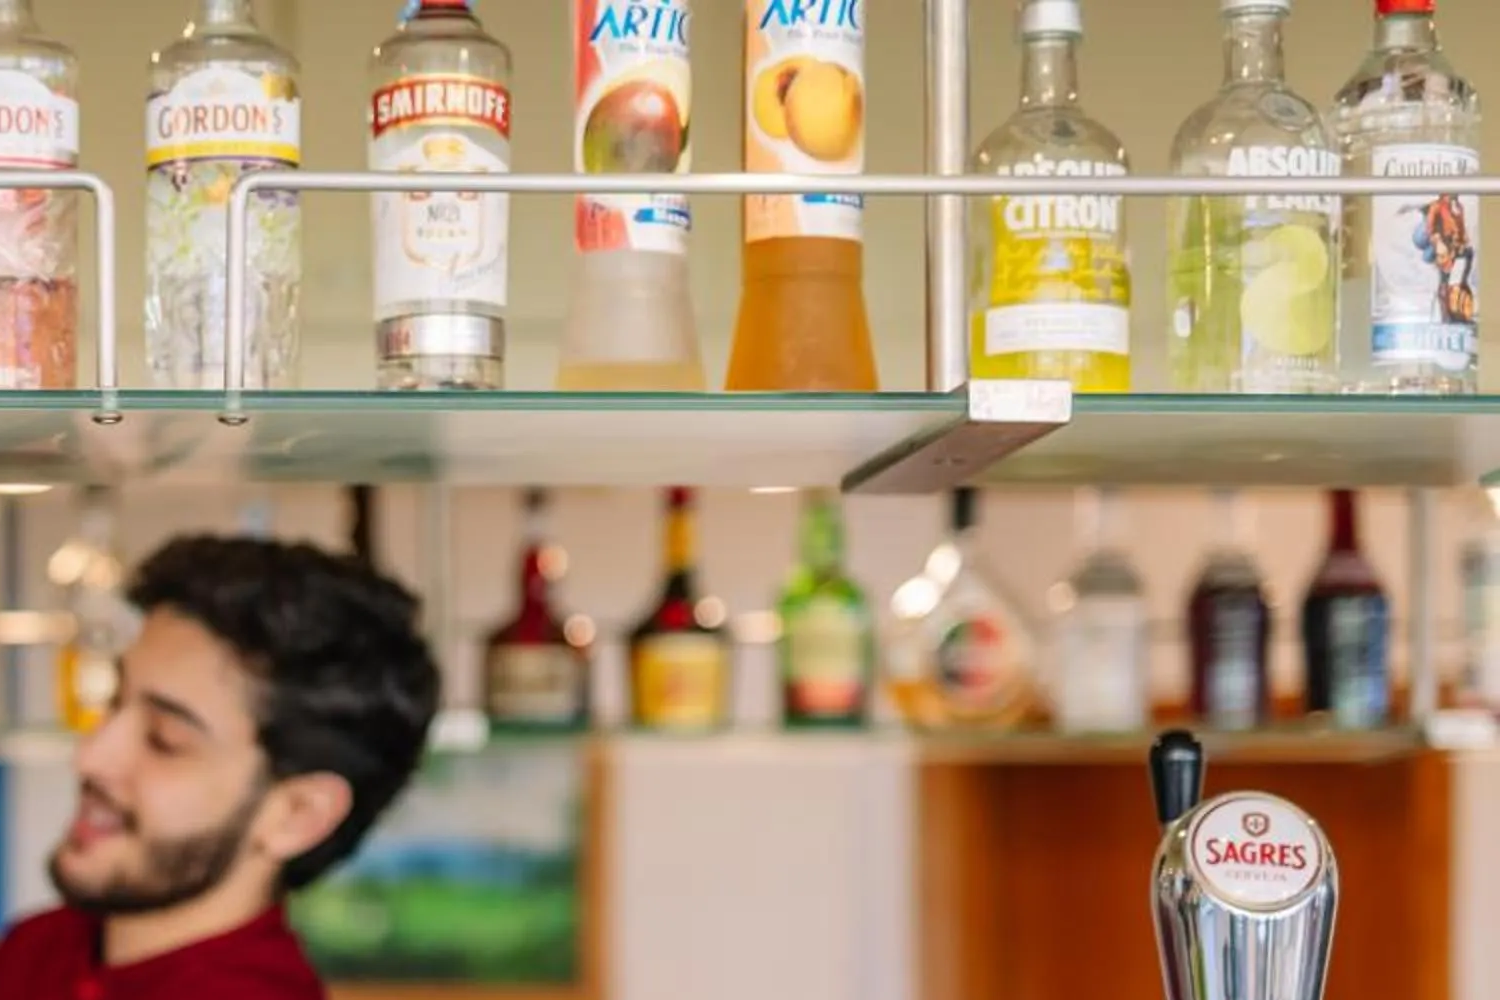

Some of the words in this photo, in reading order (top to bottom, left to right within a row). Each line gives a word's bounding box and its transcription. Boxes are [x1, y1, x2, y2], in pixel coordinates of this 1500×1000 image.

[377, 81, 507, 123] SMIRNOFF
[1004, 193, 1119, 231] CITRON
[1205, 837, 1307, 870] SAGRES
